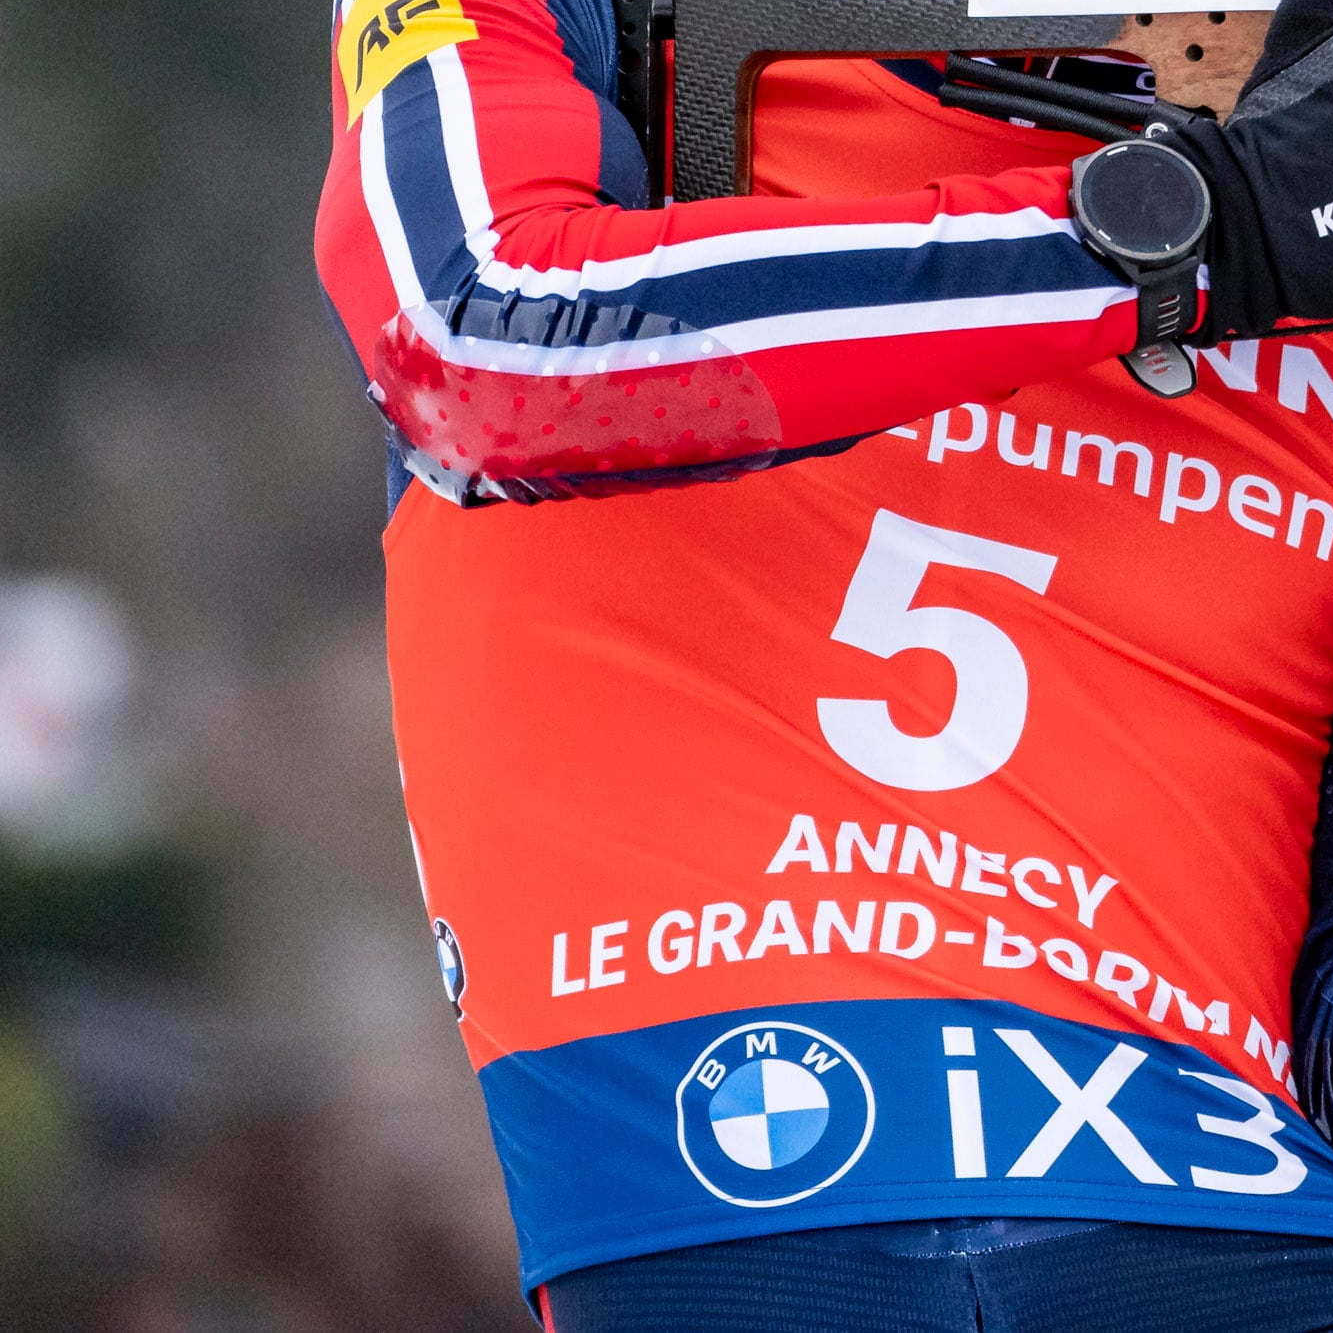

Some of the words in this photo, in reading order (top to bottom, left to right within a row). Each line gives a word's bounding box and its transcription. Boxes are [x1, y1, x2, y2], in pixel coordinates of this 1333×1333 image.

[816, 507, 1059, 792] 5
[766, 813, 1119, 930] ANNECY
[551, 920, 629, 997] LE
[696, 1031, 844, 1090] BMW
[942, 1026, 1309, 1196] iX3
